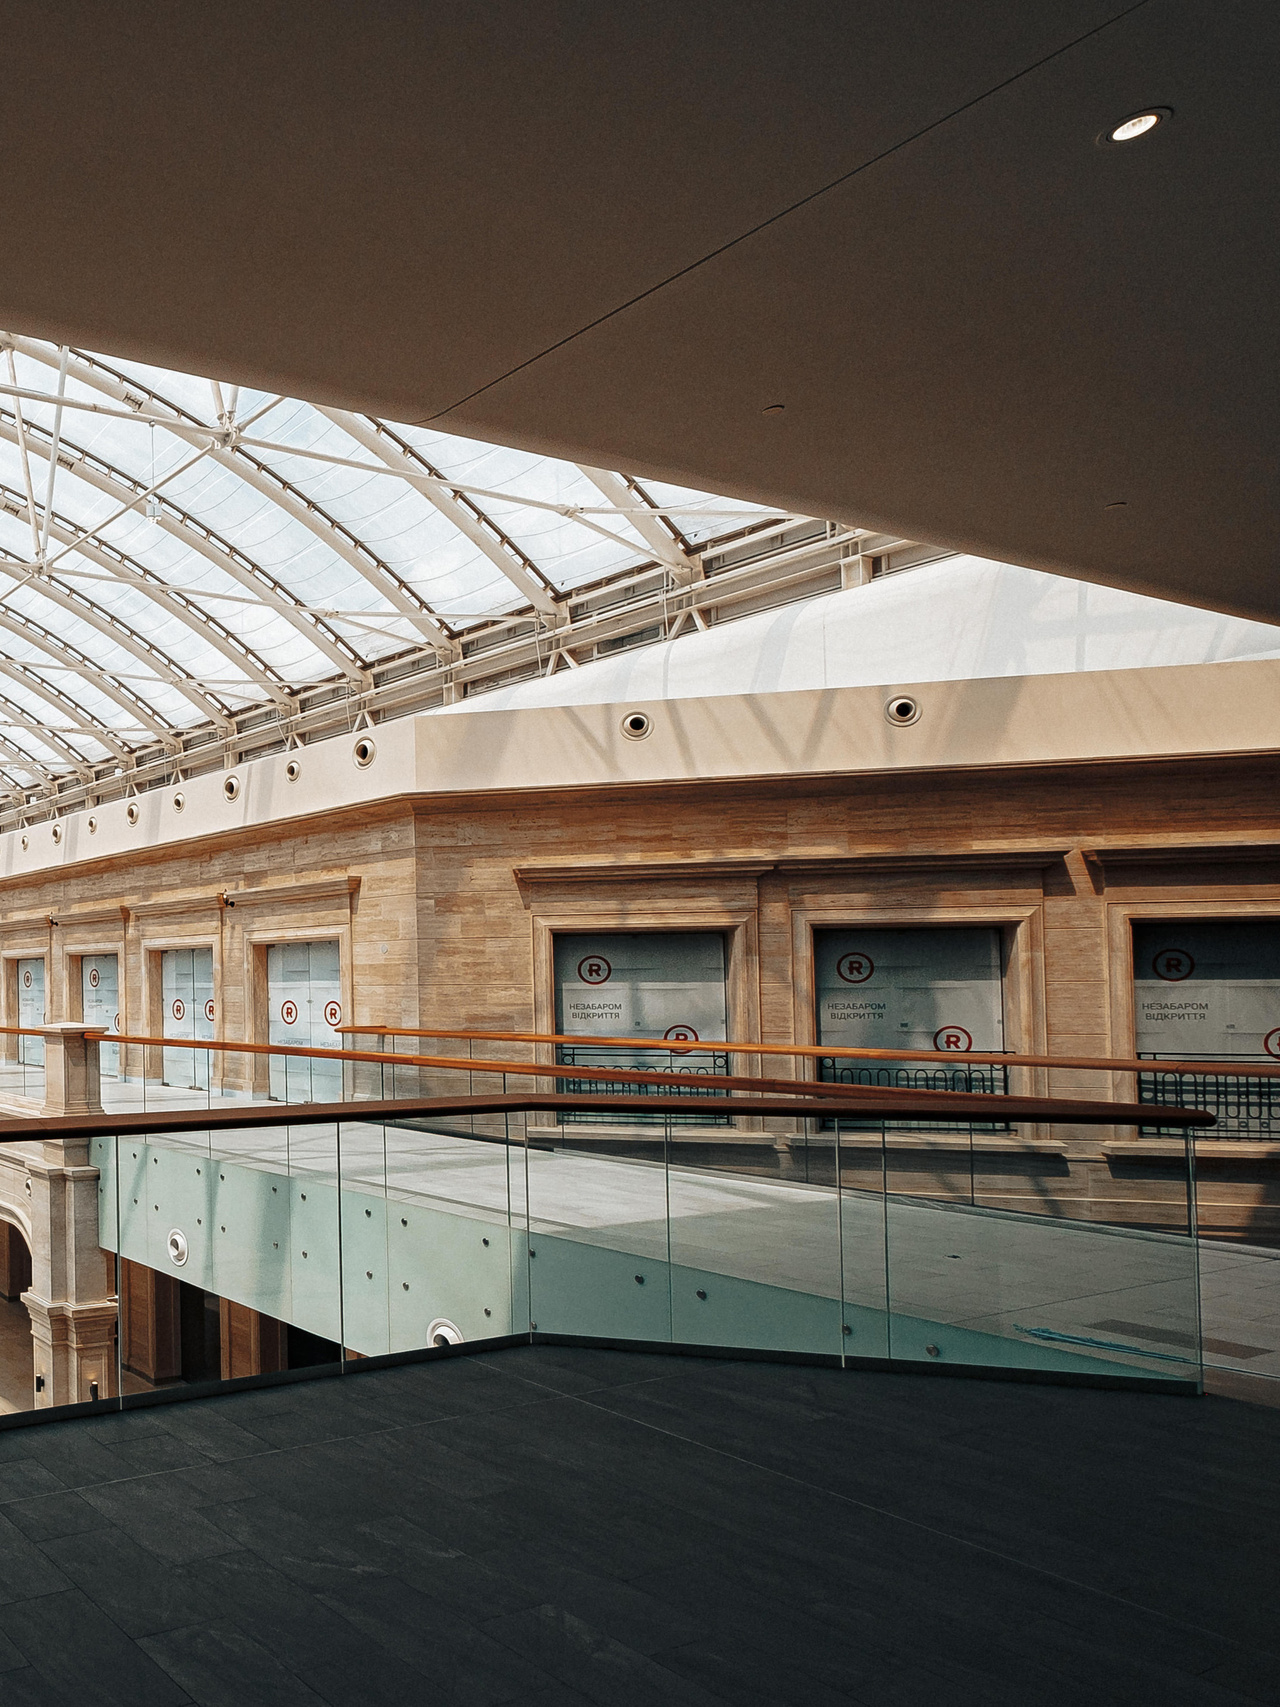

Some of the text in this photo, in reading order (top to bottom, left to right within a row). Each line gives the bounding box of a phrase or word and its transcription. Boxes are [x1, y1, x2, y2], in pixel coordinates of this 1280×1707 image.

[1142, 1002, 1209, 1010] НЕЗАБАРОМ
[571, 1012, 620, 1020] ВІДКРИТТЯ
[830, 1012, 884, 1020] ВІДКРИТТЯ
[1145, 1012, 1206, 1021] ВІДКРИТТЯ
